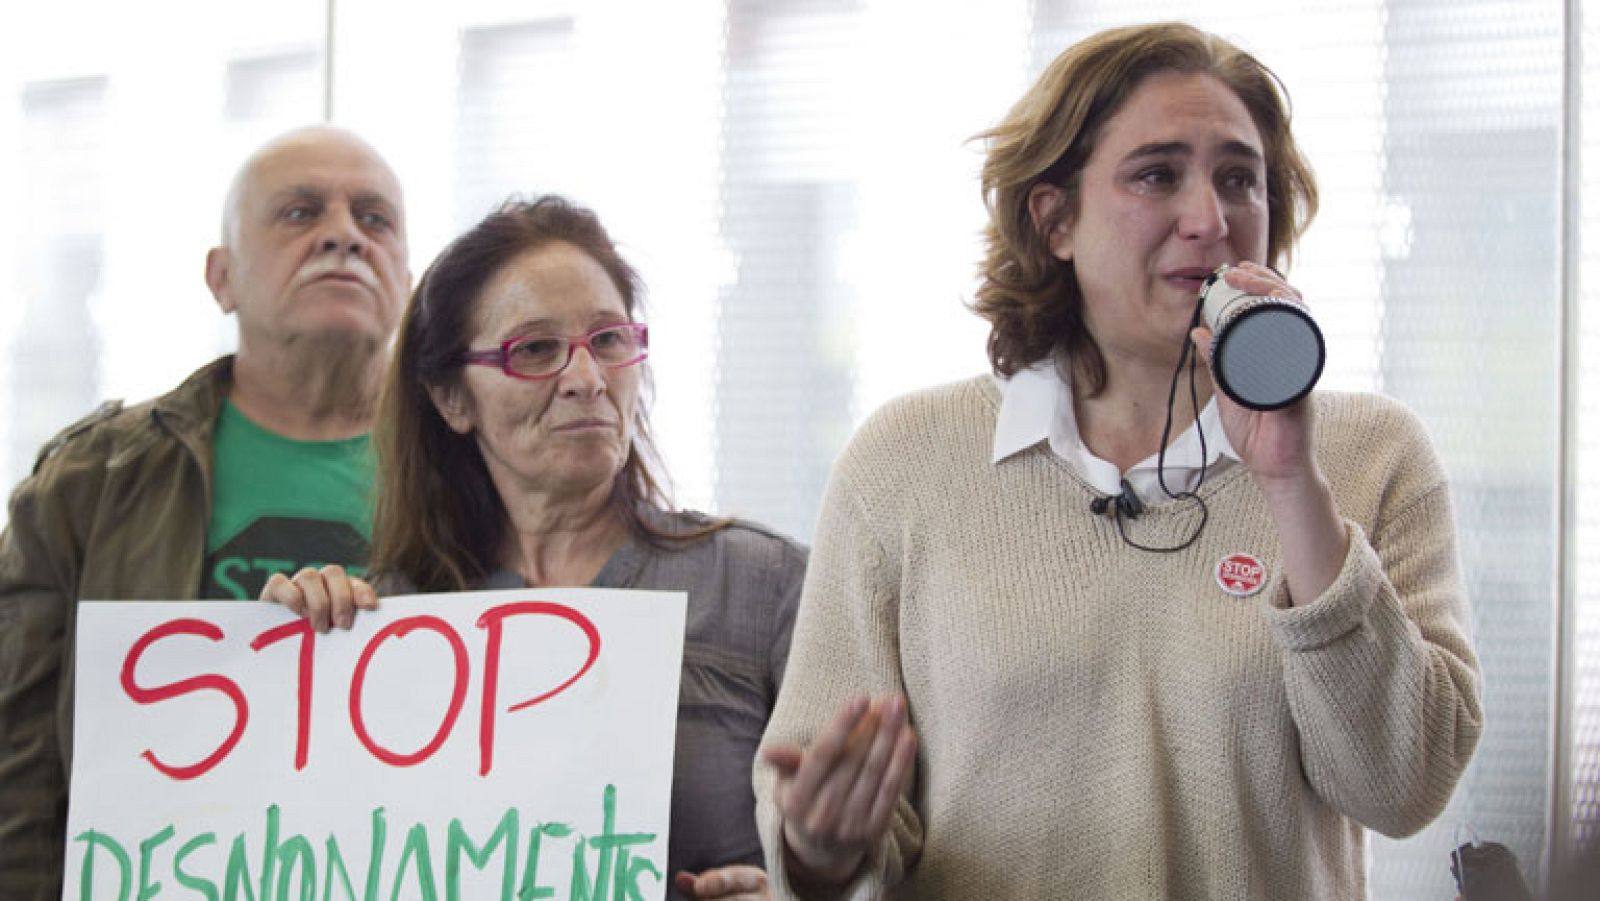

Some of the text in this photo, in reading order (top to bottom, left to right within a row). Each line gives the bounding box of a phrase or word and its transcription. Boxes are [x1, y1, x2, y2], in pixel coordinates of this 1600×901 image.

[213, 557, 368, 600] ST
[1222, 560, 1261, 577] STOP
[120, 600, 601, 780] STOP
